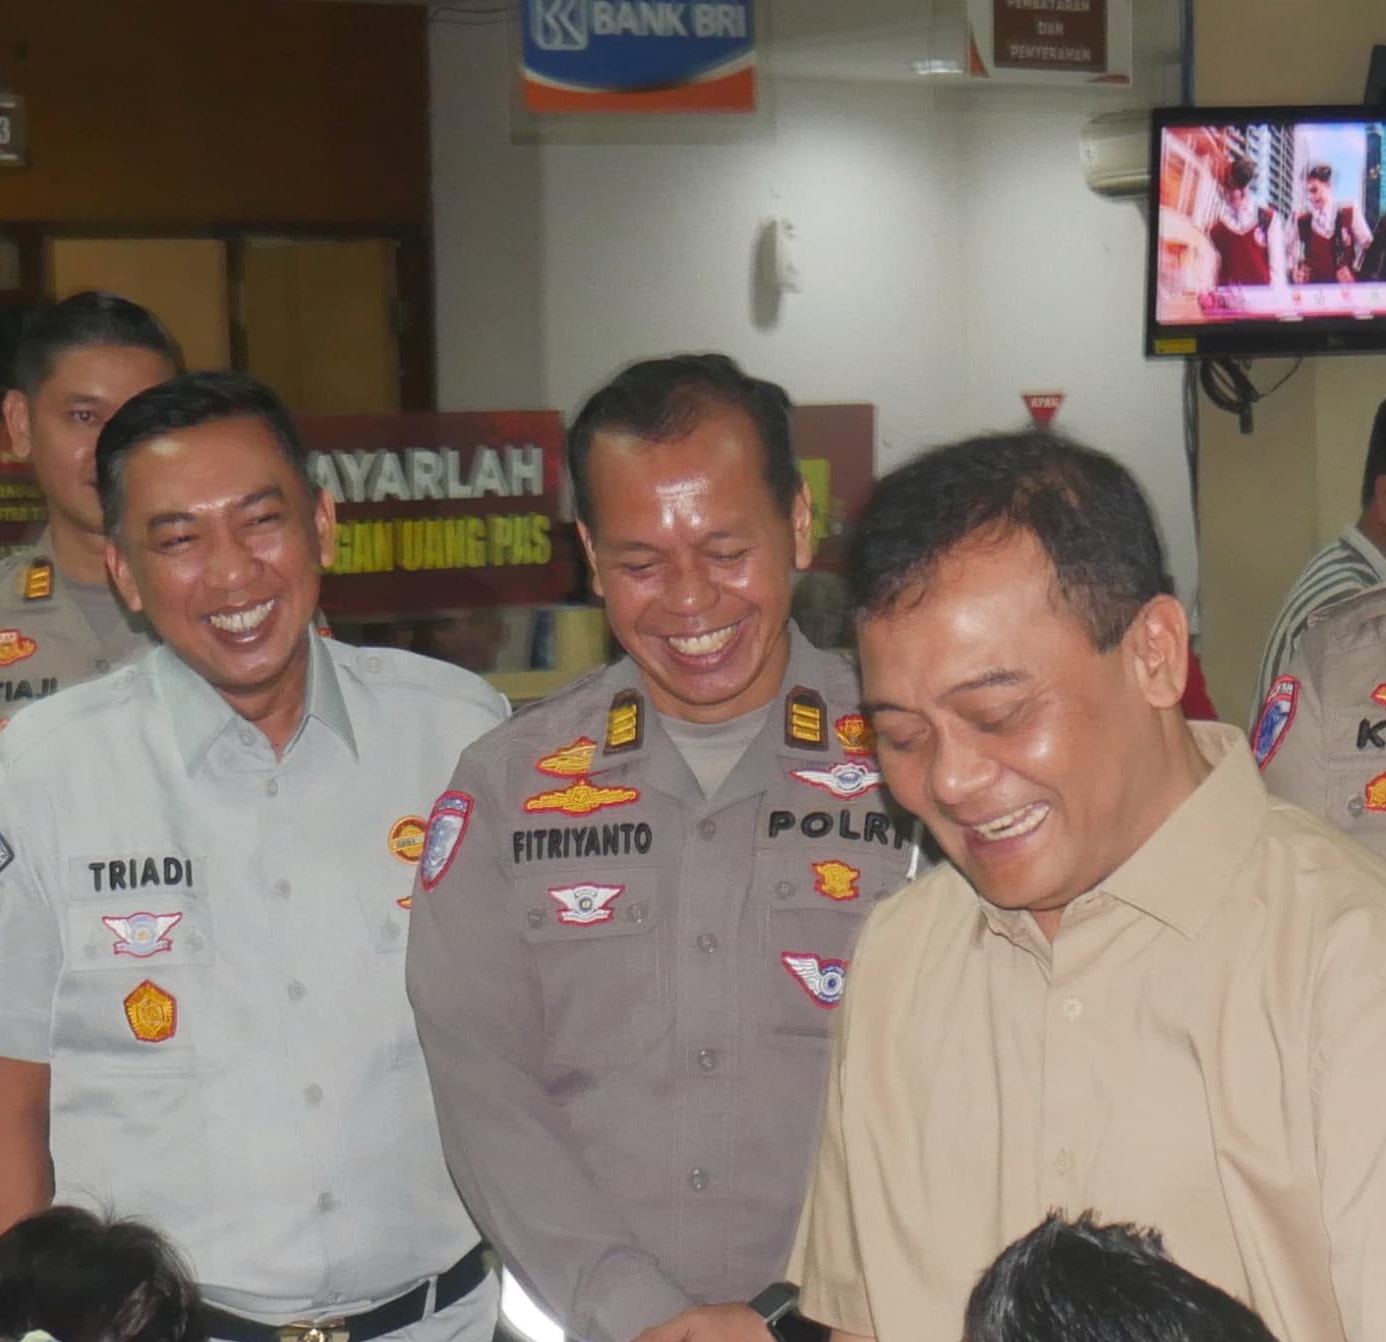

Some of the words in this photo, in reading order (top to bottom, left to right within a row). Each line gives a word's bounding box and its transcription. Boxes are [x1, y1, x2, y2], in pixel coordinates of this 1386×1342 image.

[592, 0, 688, 37] BANK
[692, 5, 747, 38] BRI
[310, 445, 544, 503] AYARLAH
[332, 521, 394, 575] GAN
[400, 516, 486, 571] UANG
[488, 513, 551, 566] PAS
[513, 822, 653, 863] FITRIYANTO
[769, 809, 915, 850] POLRI
[89, 858, 193, 892] TRIADI
